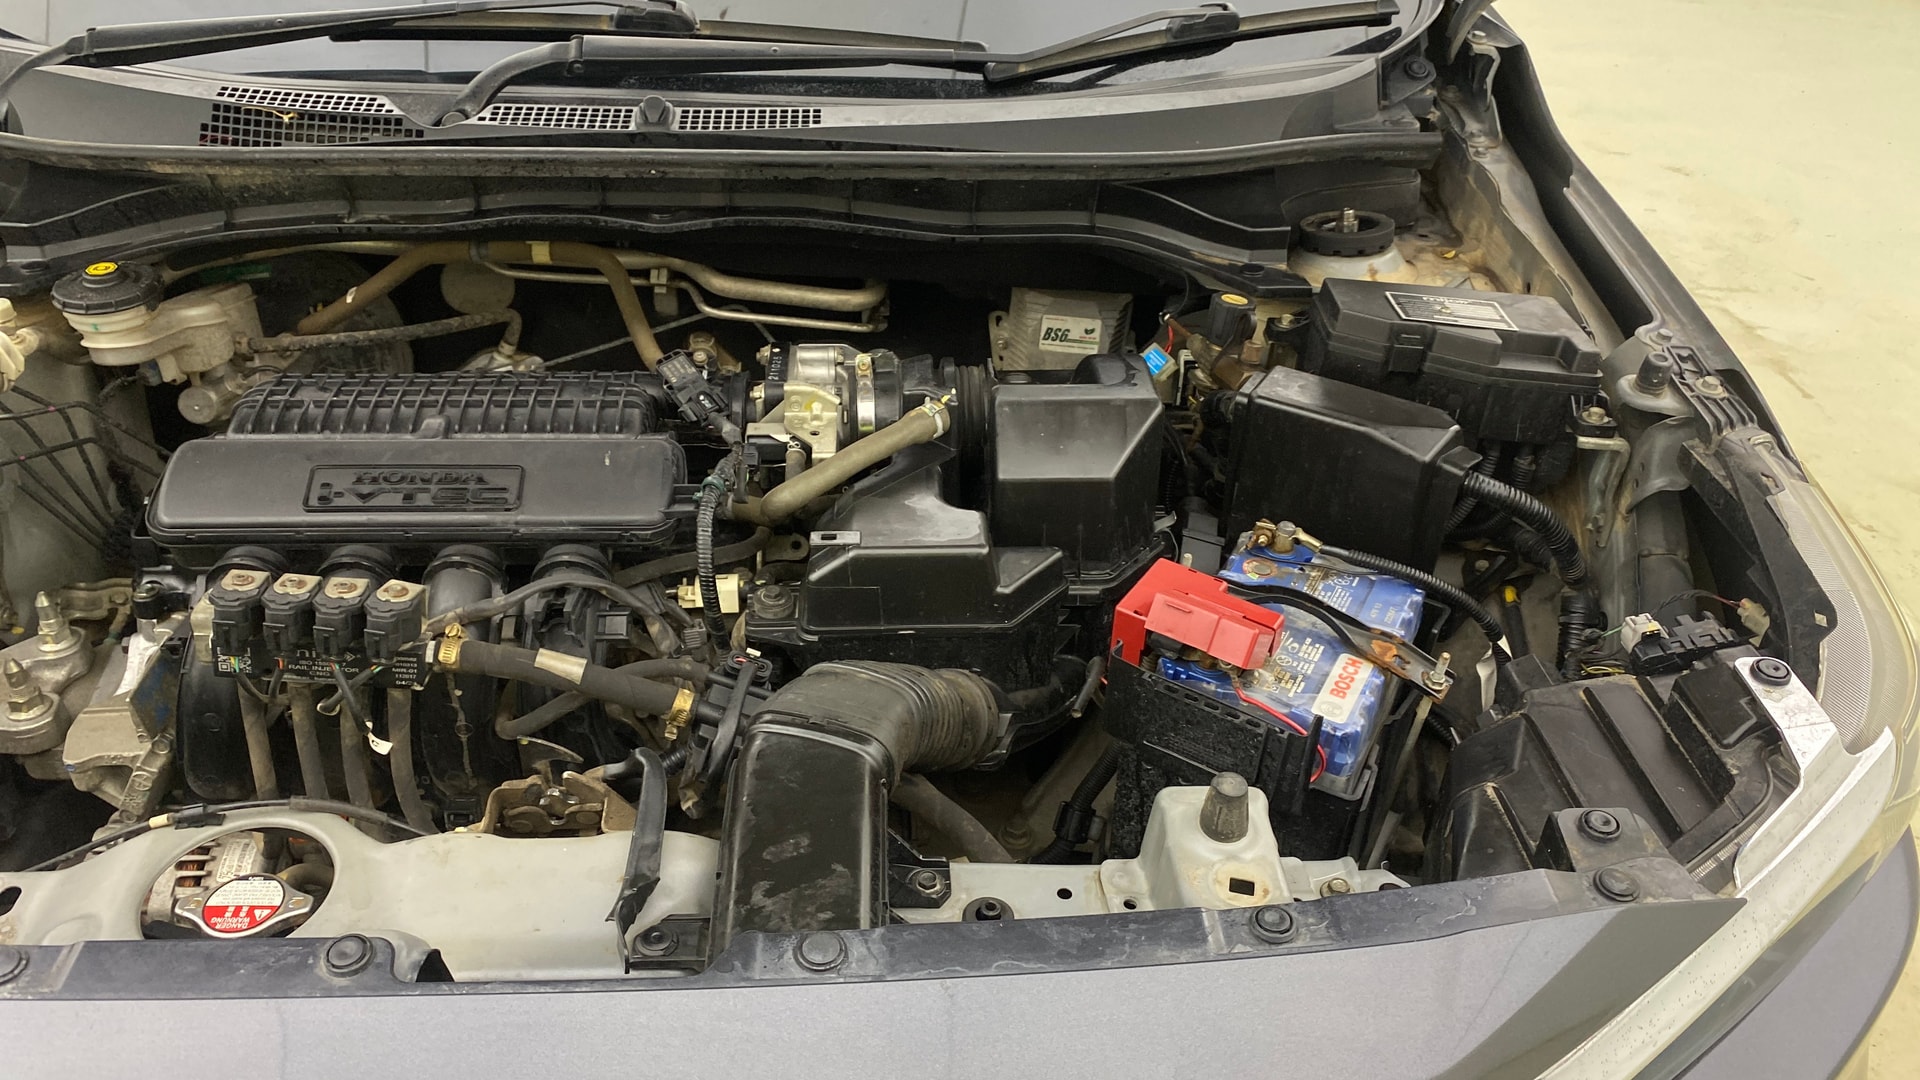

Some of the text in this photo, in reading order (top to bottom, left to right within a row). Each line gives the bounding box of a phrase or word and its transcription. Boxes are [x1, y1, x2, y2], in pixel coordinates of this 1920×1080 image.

[351, 470, 490, 486] HONDA
[312, 665, 360, 674] INJEOR
[1329, 656, 1364, 700] BOSCH
